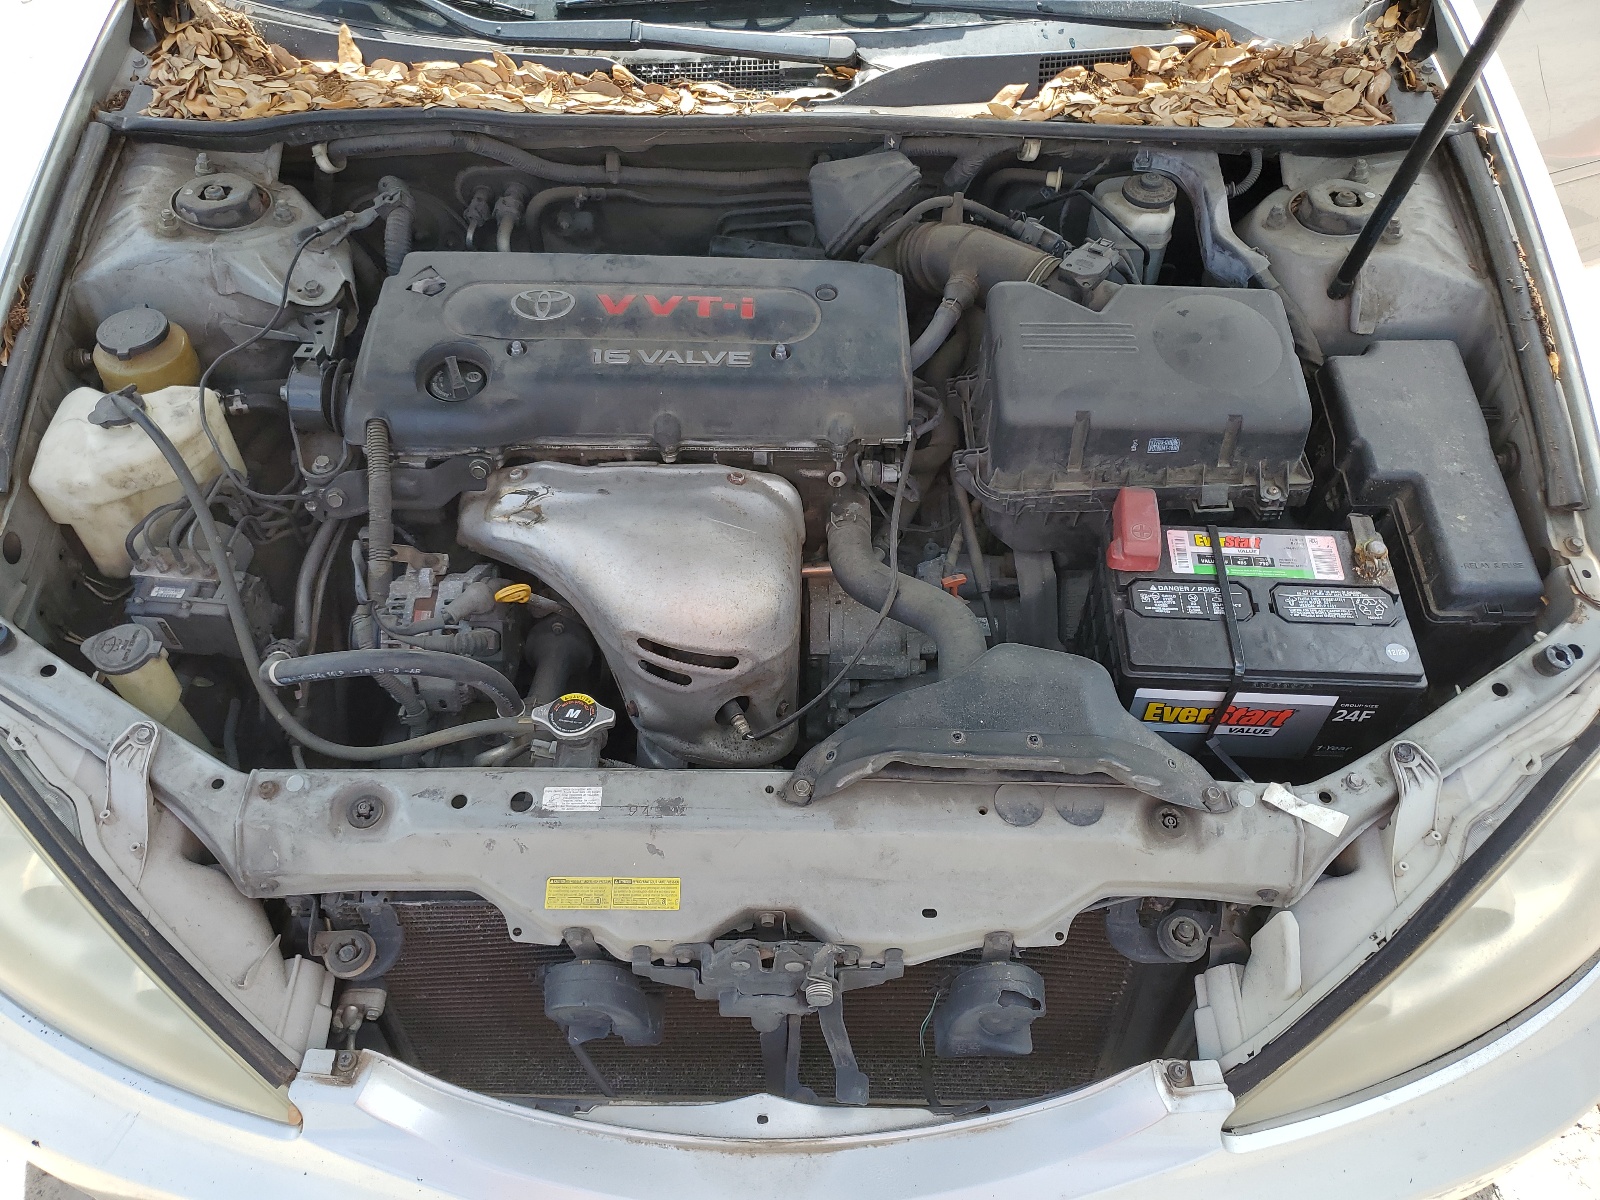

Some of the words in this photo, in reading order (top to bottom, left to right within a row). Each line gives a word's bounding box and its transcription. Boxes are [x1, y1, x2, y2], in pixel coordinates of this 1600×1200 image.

[596, 294, 755, 319] VVT-i
[593, 348, 631, 364] 16
[637, 349, 751, 367] VALVE
[1387, 648, 1407, 656] 12/23
[565, 709, 582, 719] M
[1331, 709, 1376, 722] 24F
[1228, 727, 1272, 735] VALUE
